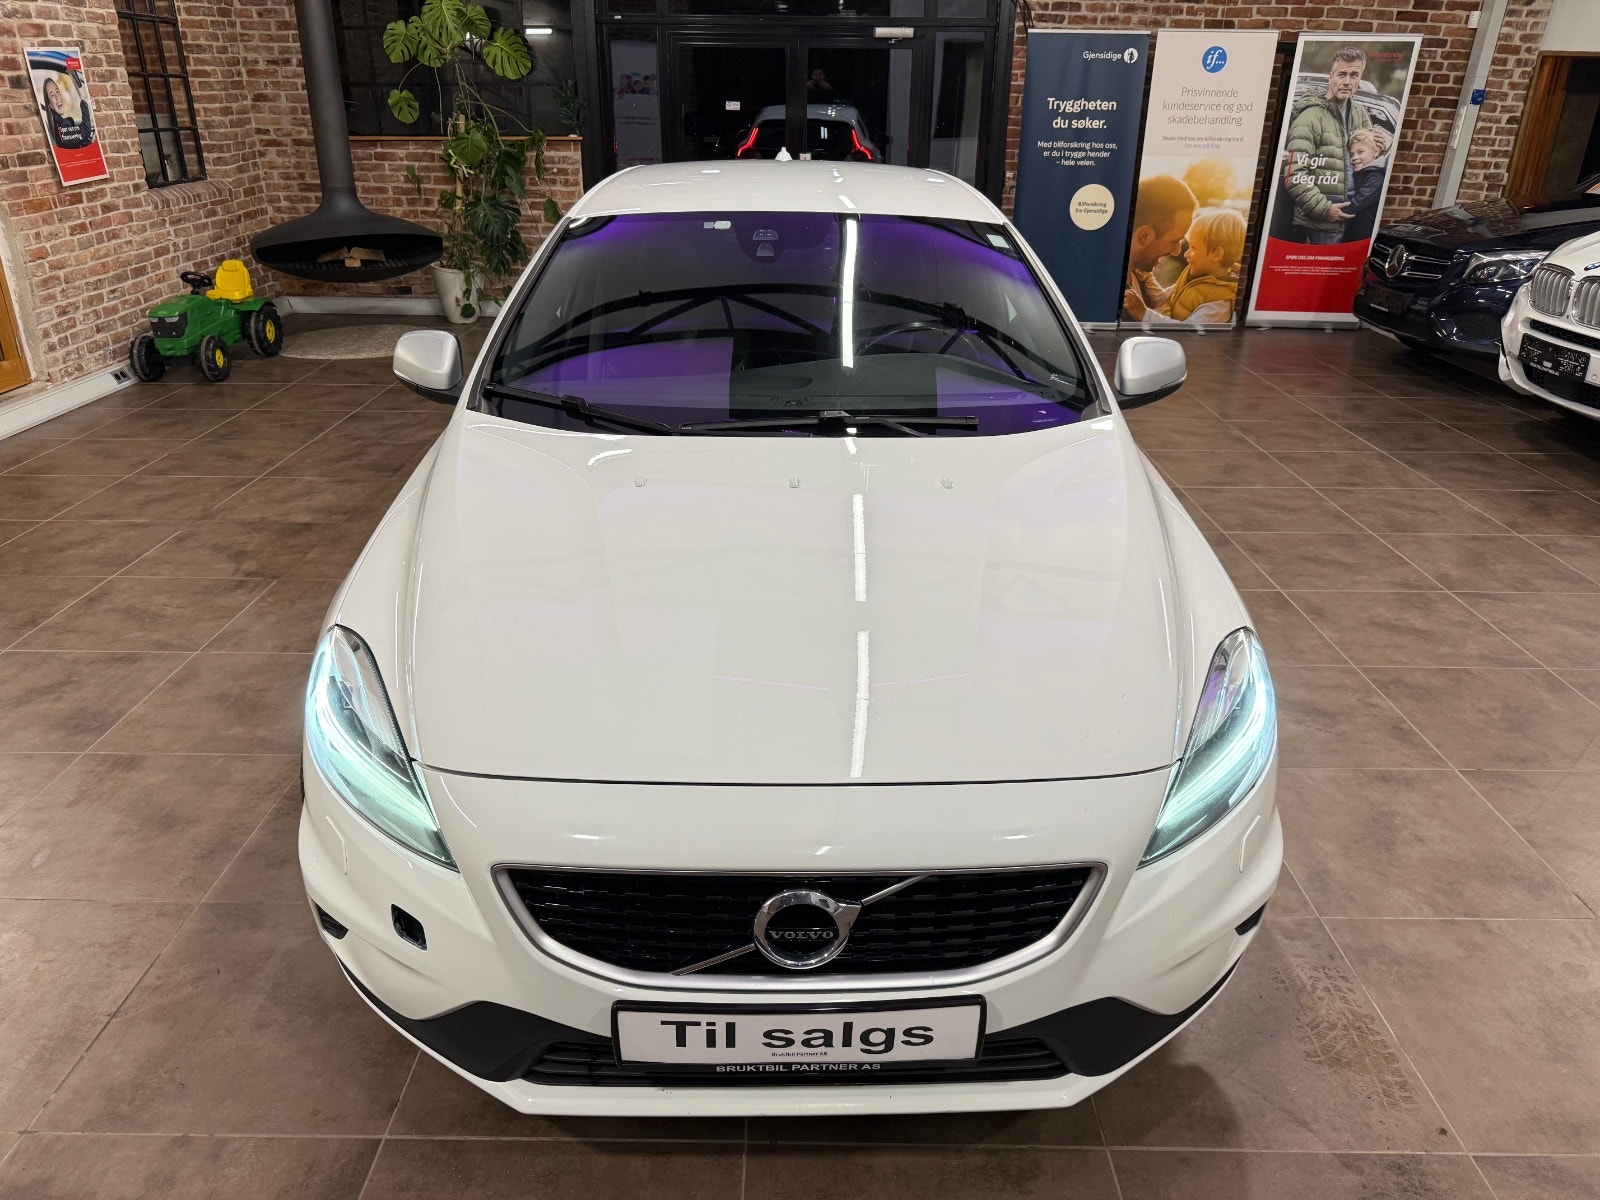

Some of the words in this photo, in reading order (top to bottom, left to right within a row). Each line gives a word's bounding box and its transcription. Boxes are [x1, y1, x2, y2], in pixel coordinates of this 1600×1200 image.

[1082, 51, 1122, 61] Gjensidige
[1181, 87, 1239, 98] Prisvinnende
[1047, 97, 1117, 113] Tryggheten
[1162, 101, 1221, 112] kundeservice
[1223, 103, 1234, 113] og
[1236, 102, 1254, 113] god
[1052, 117, 1068, 129] du
[1071, 117, 1107, 129] søker.
[1167, 114, 1244, 126] skadebehandling.
[1053, 141, 1090, 150] bilforsikring
[1297, 154, 1309, 166] Vi
[1310, 155, 1328, 169] gir
[1292, 174, 1316, 186] deg
[1318, 171, 1339, 185] råd
[768, 930, 834, 939] VOLVO
[660, 1020, 736, 1049] Til
[761, 1021, 934, 1055] salgs
[716, 1064, 788, 1072] BRUKTBIL
[791, 1063, 858, 1071] PARTNER
